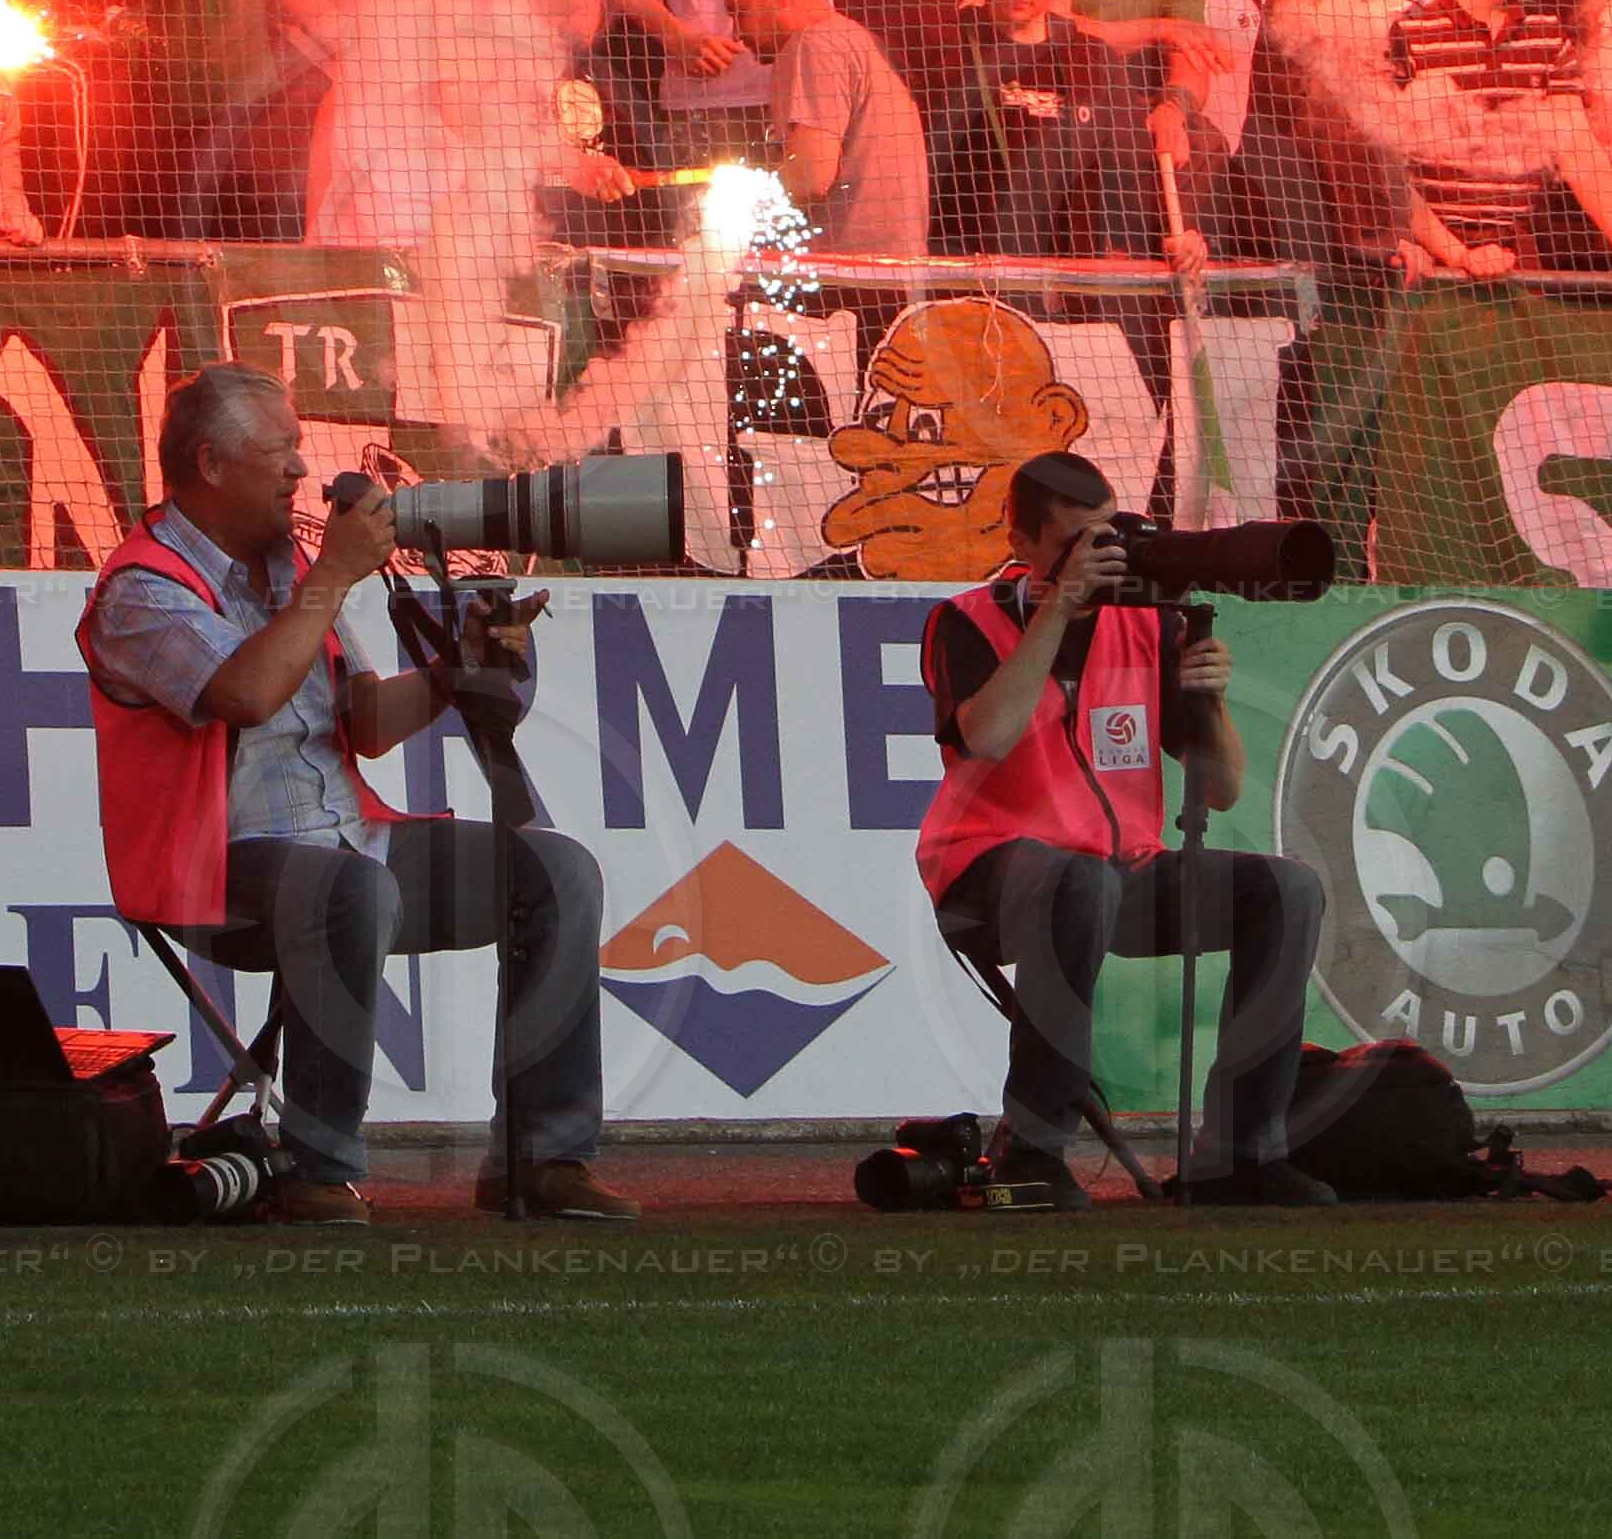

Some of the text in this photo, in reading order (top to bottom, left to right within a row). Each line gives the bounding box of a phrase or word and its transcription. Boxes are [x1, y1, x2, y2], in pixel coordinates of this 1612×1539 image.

[260, 321, 365, 392] TR
[1099, 753, 1145, 766] LIGA
[1381, 989, 1585, 1057] AUTO
